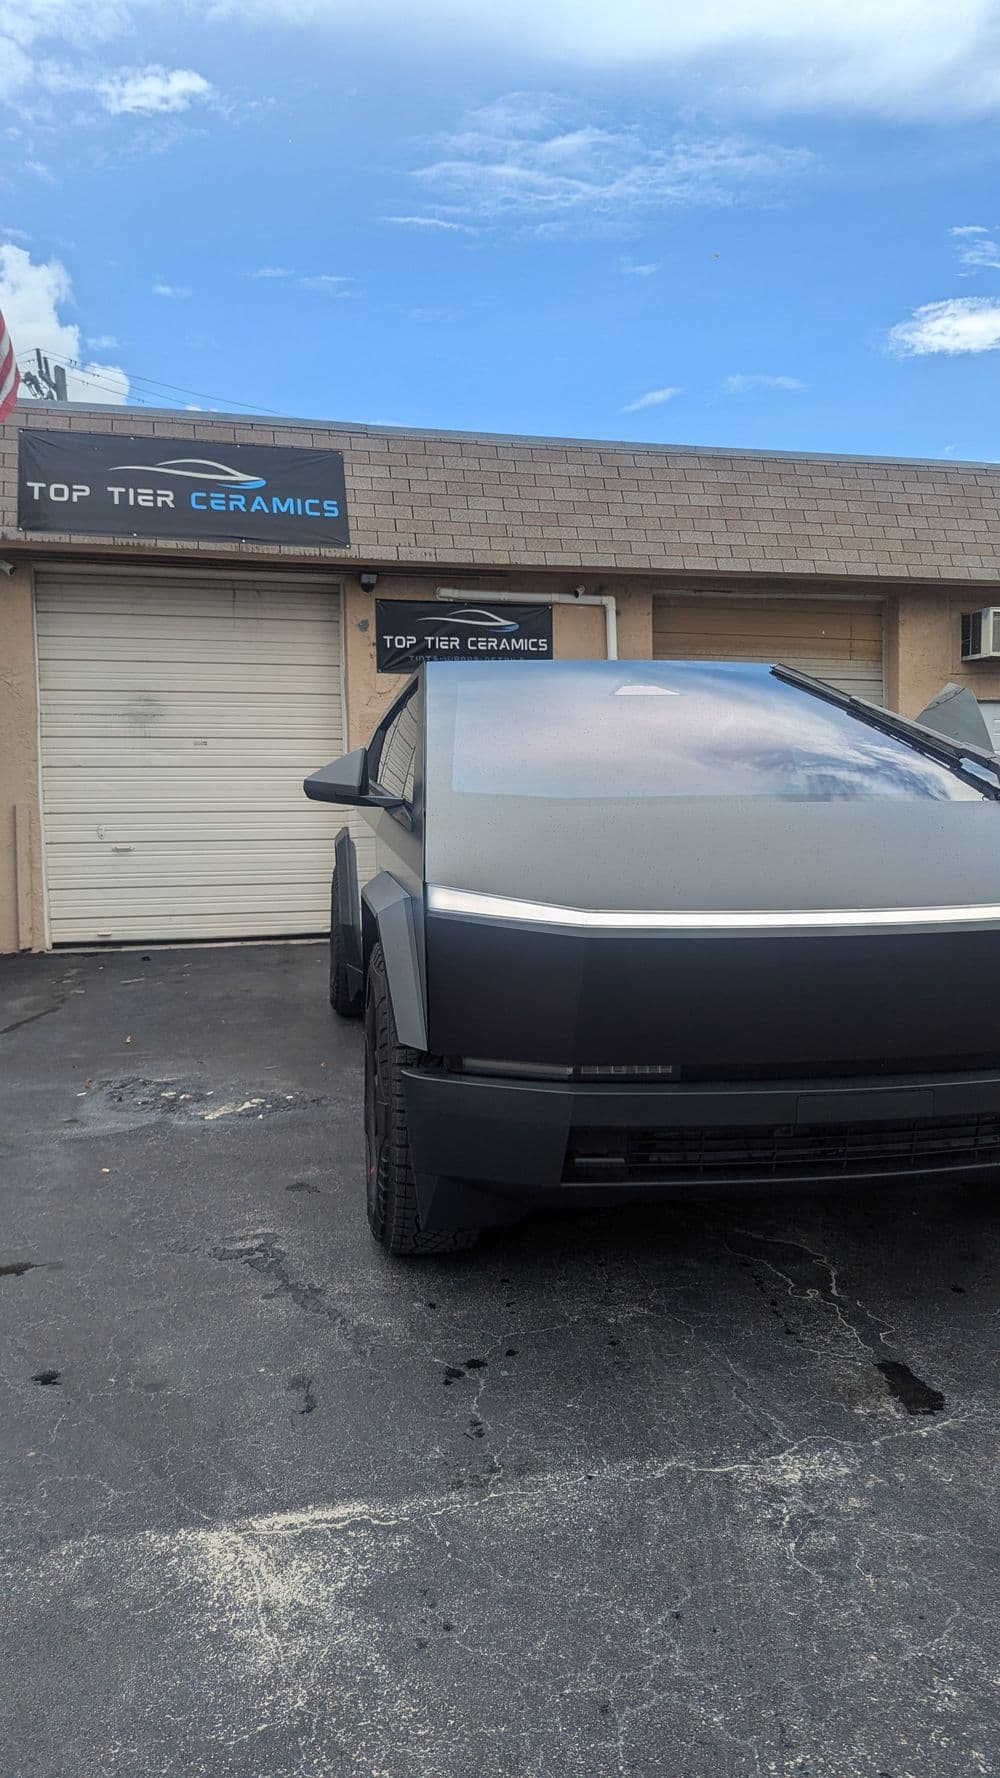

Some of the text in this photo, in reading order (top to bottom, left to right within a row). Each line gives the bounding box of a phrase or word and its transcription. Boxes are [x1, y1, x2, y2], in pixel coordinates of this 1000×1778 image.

[27, 482, 339, 517] TOP TIER CERAMICS
[383, 635, 548, 652] TOP TIER CERAMICS
